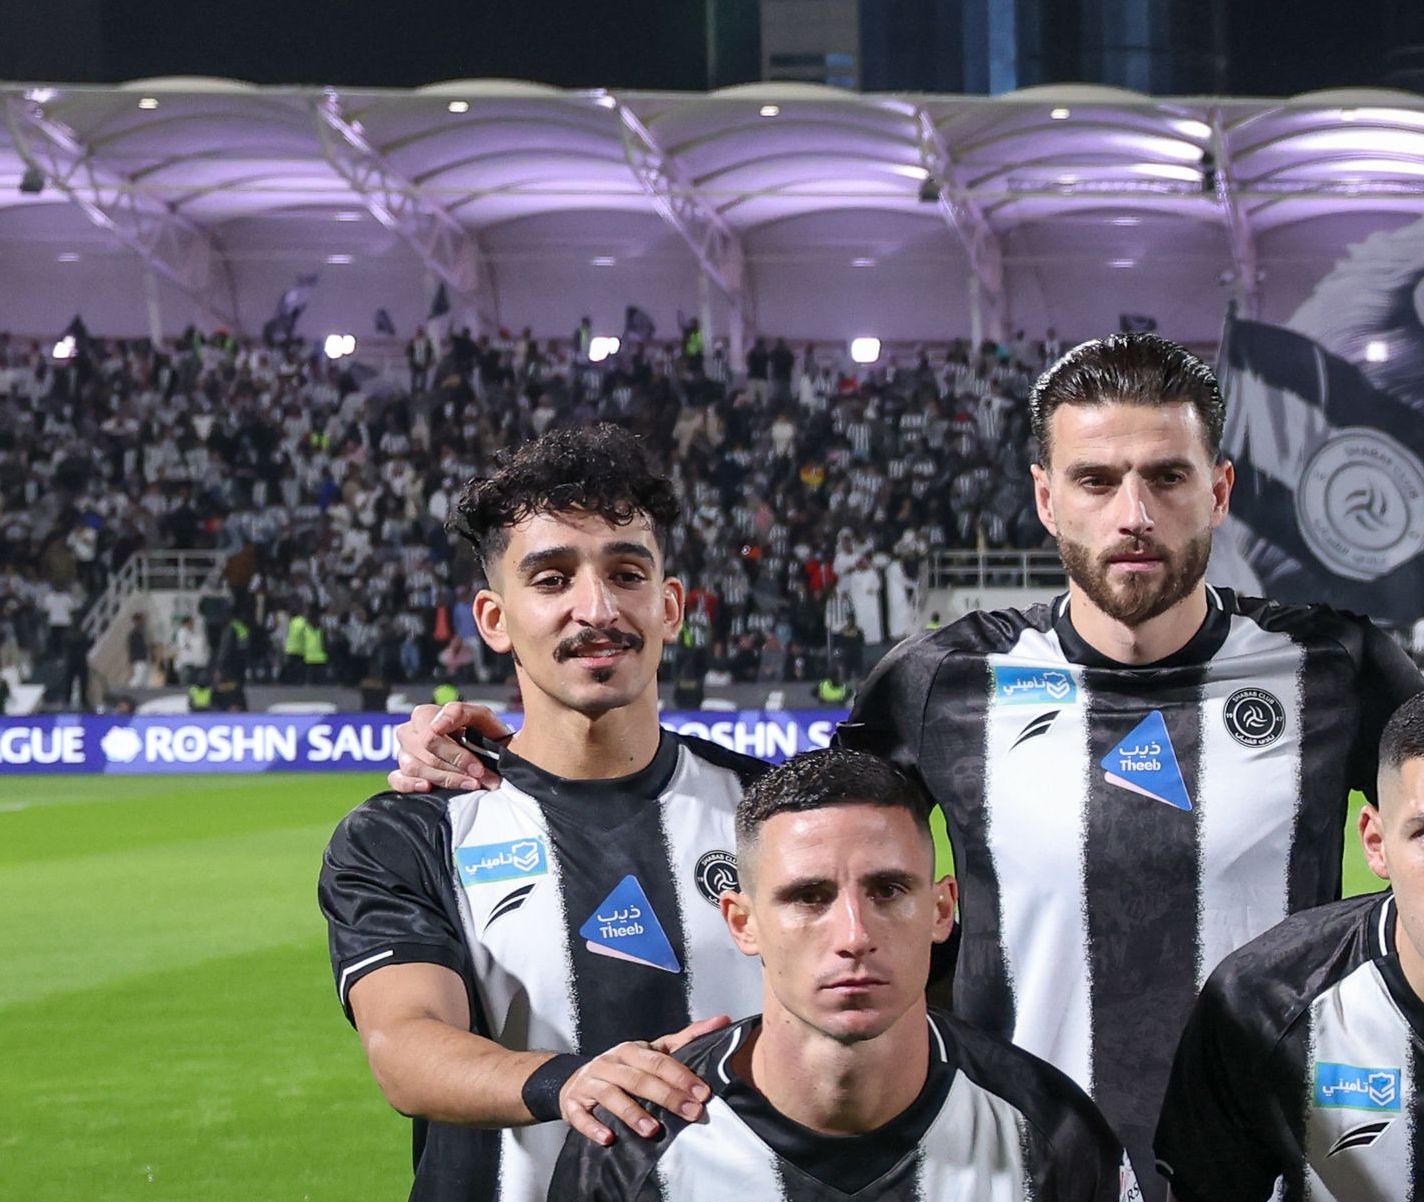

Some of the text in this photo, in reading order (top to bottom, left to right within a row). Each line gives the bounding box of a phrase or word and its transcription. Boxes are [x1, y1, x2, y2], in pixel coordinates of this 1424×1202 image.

[145, 725, 296, 763] ROSHN
[1119, 741, 1161, 759] ذيب
[1119, 758, 1161, 771] Theeb
[597, 904, 641, 925] ذيب
[600, 922, 644, 938] Theeb
